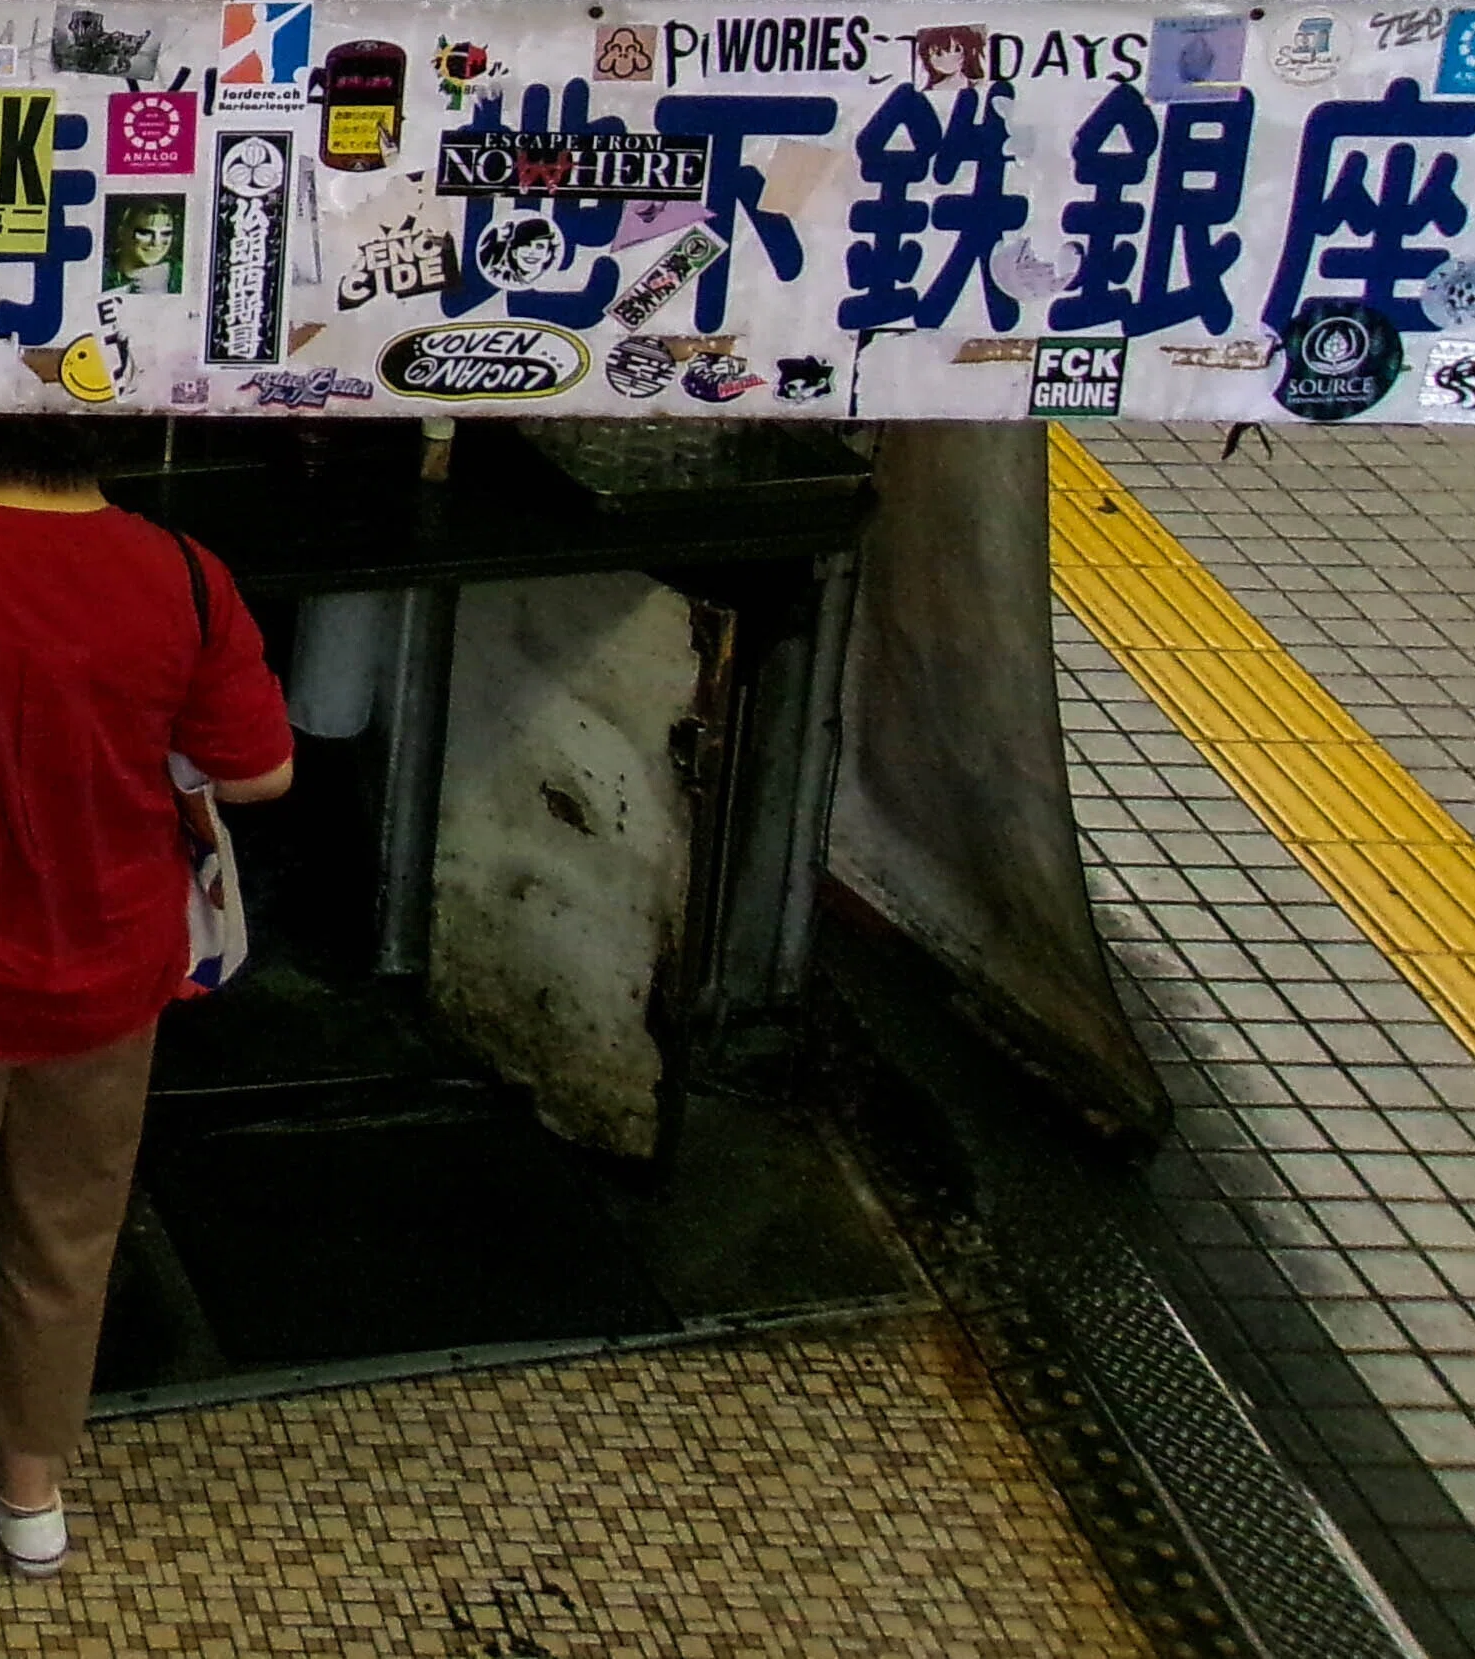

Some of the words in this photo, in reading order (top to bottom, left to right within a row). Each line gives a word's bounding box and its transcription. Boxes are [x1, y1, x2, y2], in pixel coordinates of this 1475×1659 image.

[717, 15, 870, 72] WORIES
[485, 133, 580, 149] ESCAPE
[593, 136, 663, 150] FROM
[441, 147, 704, 190] NOWHERE
[426, 330, 543, 357] JOVEN
[1037, 348, 1123, 378] FCK
[1034, 377, 1117, 408] GRÜNE
[1288, 376, 1373, 396] SOURCE
